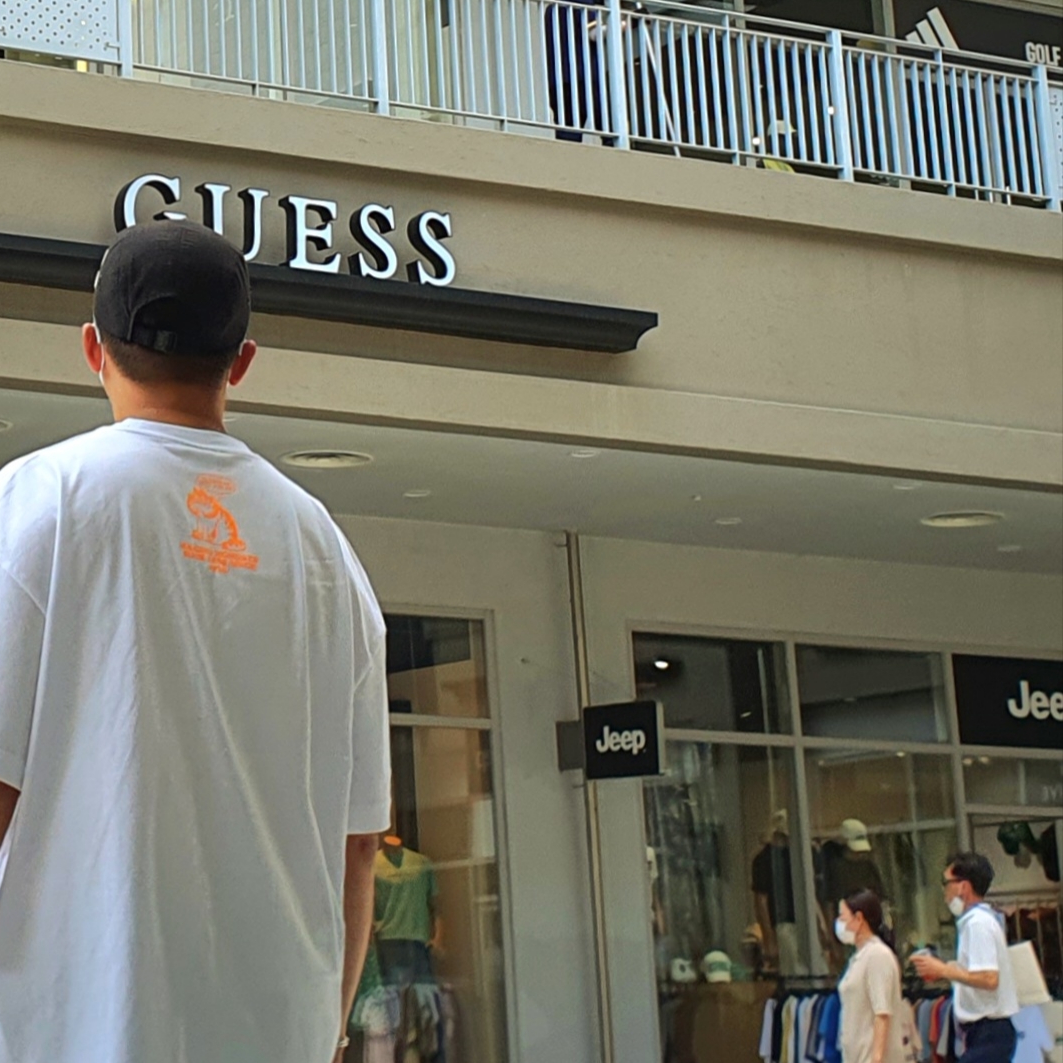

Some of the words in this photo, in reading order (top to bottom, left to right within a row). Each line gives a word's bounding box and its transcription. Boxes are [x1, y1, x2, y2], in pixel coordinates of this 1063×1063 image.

[1025, 41, 1061, 67] GOLF
[114, 173, 456, 287] GUESS
[596, 725, 646, 756] Jeep
